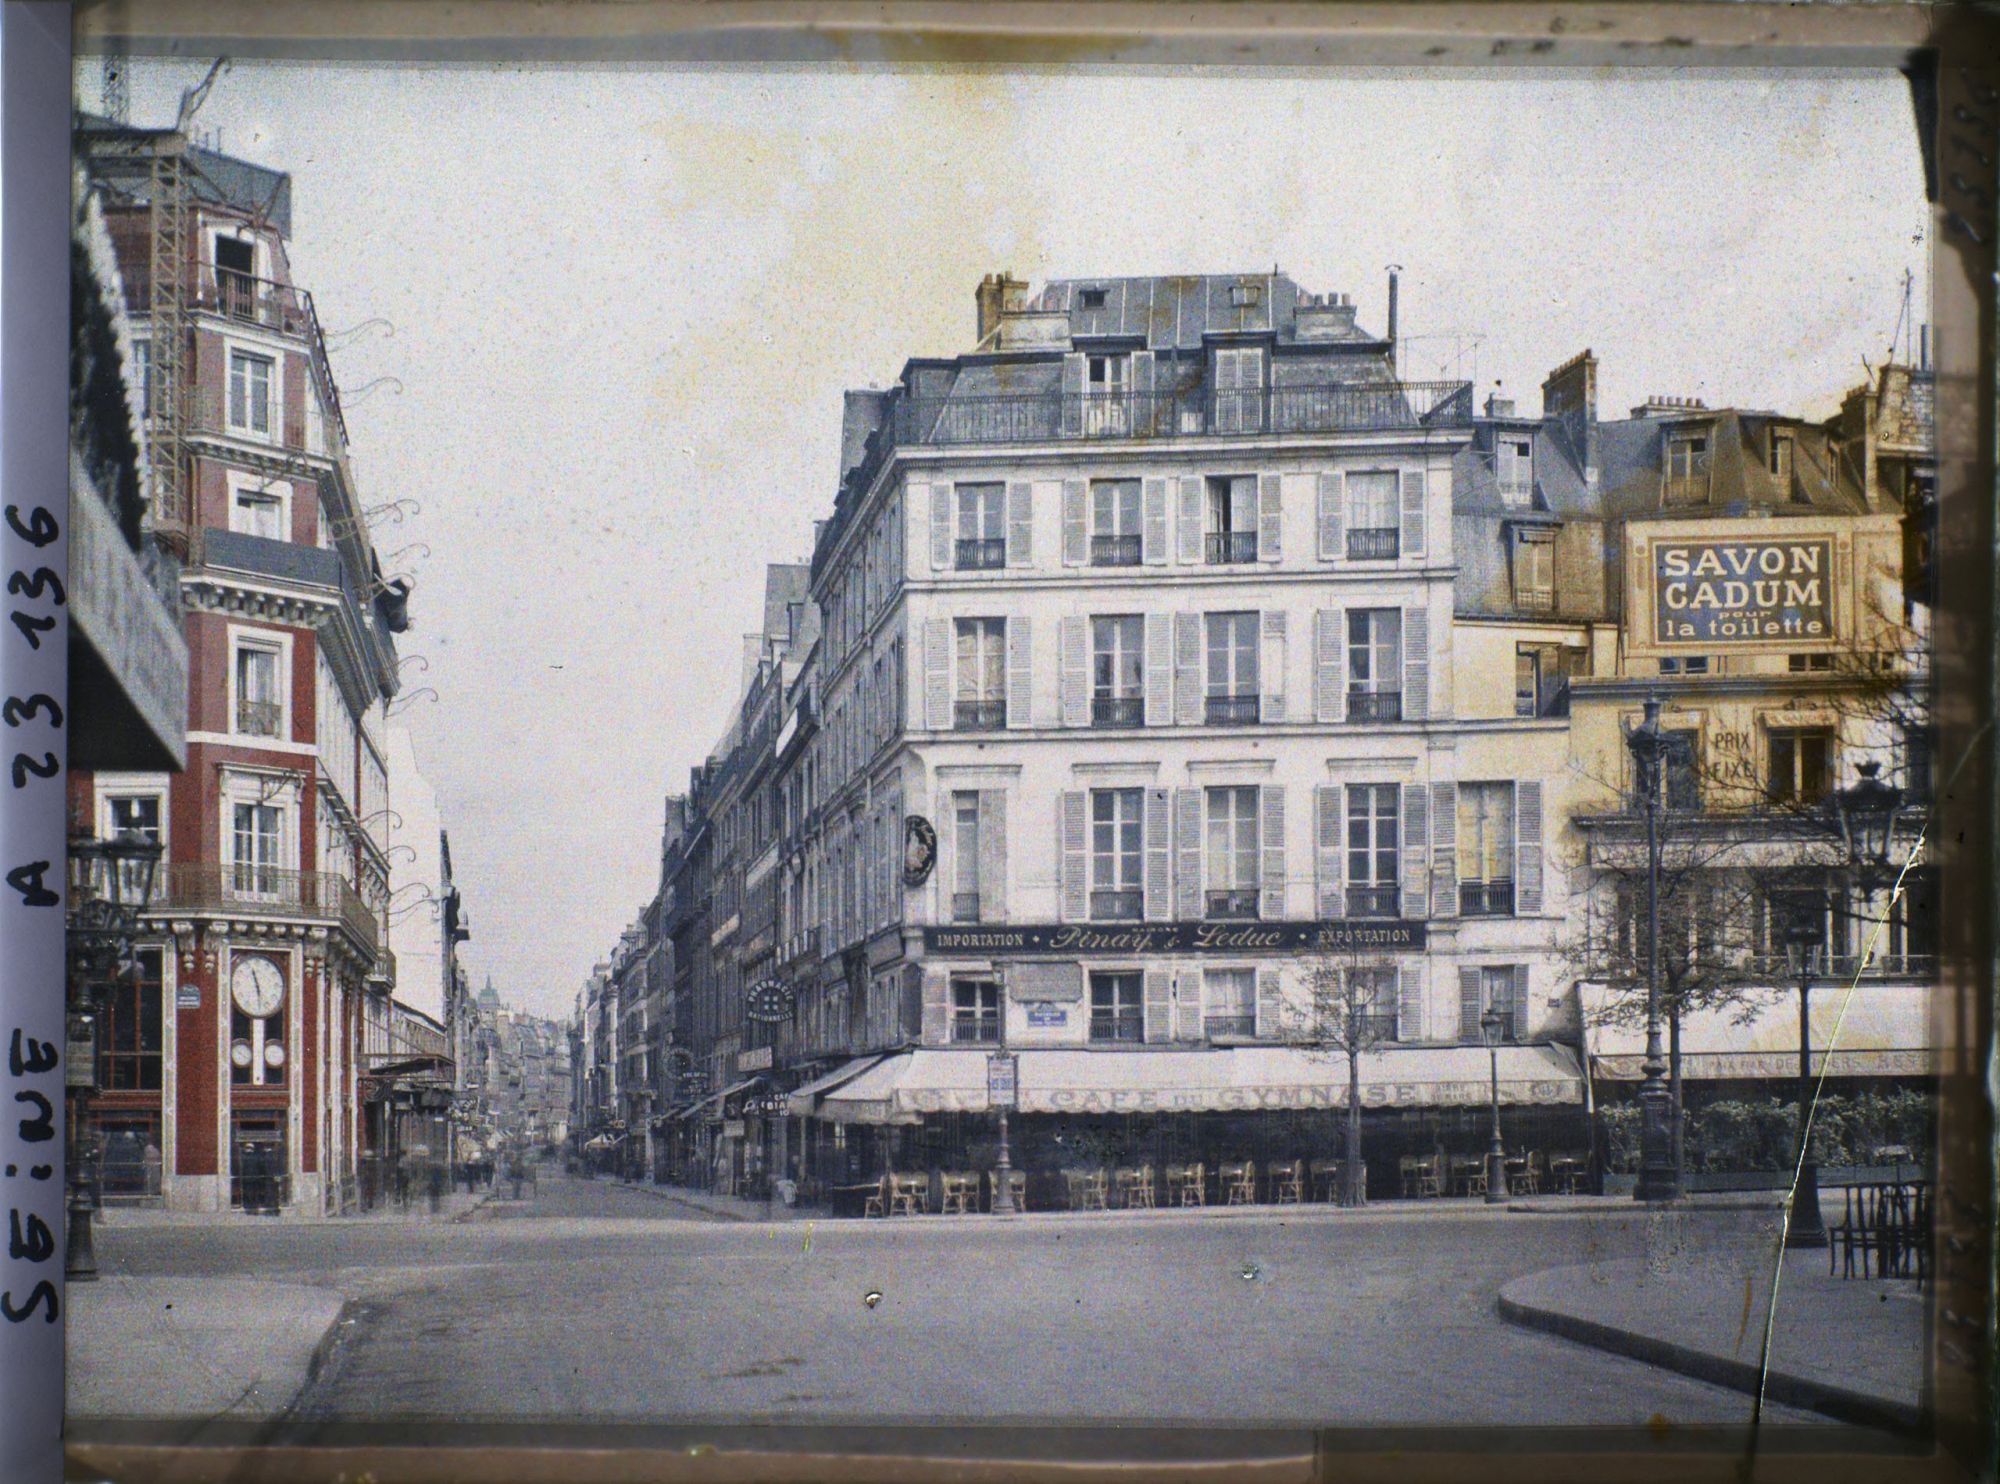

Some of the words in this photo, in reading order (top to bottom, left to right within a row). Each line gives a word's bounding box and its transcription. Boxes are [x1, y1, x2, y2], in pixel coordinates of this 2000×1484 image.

[1664, 546, 1821, 577] SAVON
[4, 505, 66, 650] 136
[1665, 579, 1823, 610] CADUM
[1666, 619, 1696, 637] la
[1709, 618, 1823, 636] toilette
[1718, 610, 1773, 620] pour
[2, 693, 63, 789] 23
[1714, 732, 1750, 750] PRIX
[1713, 760, 1753, 779] FIXE
[6, 860, 60, 907] A
[937, 933, 1024, 946] IMPORTATION
[1050, 925, 1153, 952] Pinay
[1192, 924, 1286, 948] Leduc
[1318, 929, 1411, 943] EXPORTATION
[748, 980, 794, 1003] PHARMACIE
[1218, 1084, 1416, 1108] GYMNASE
